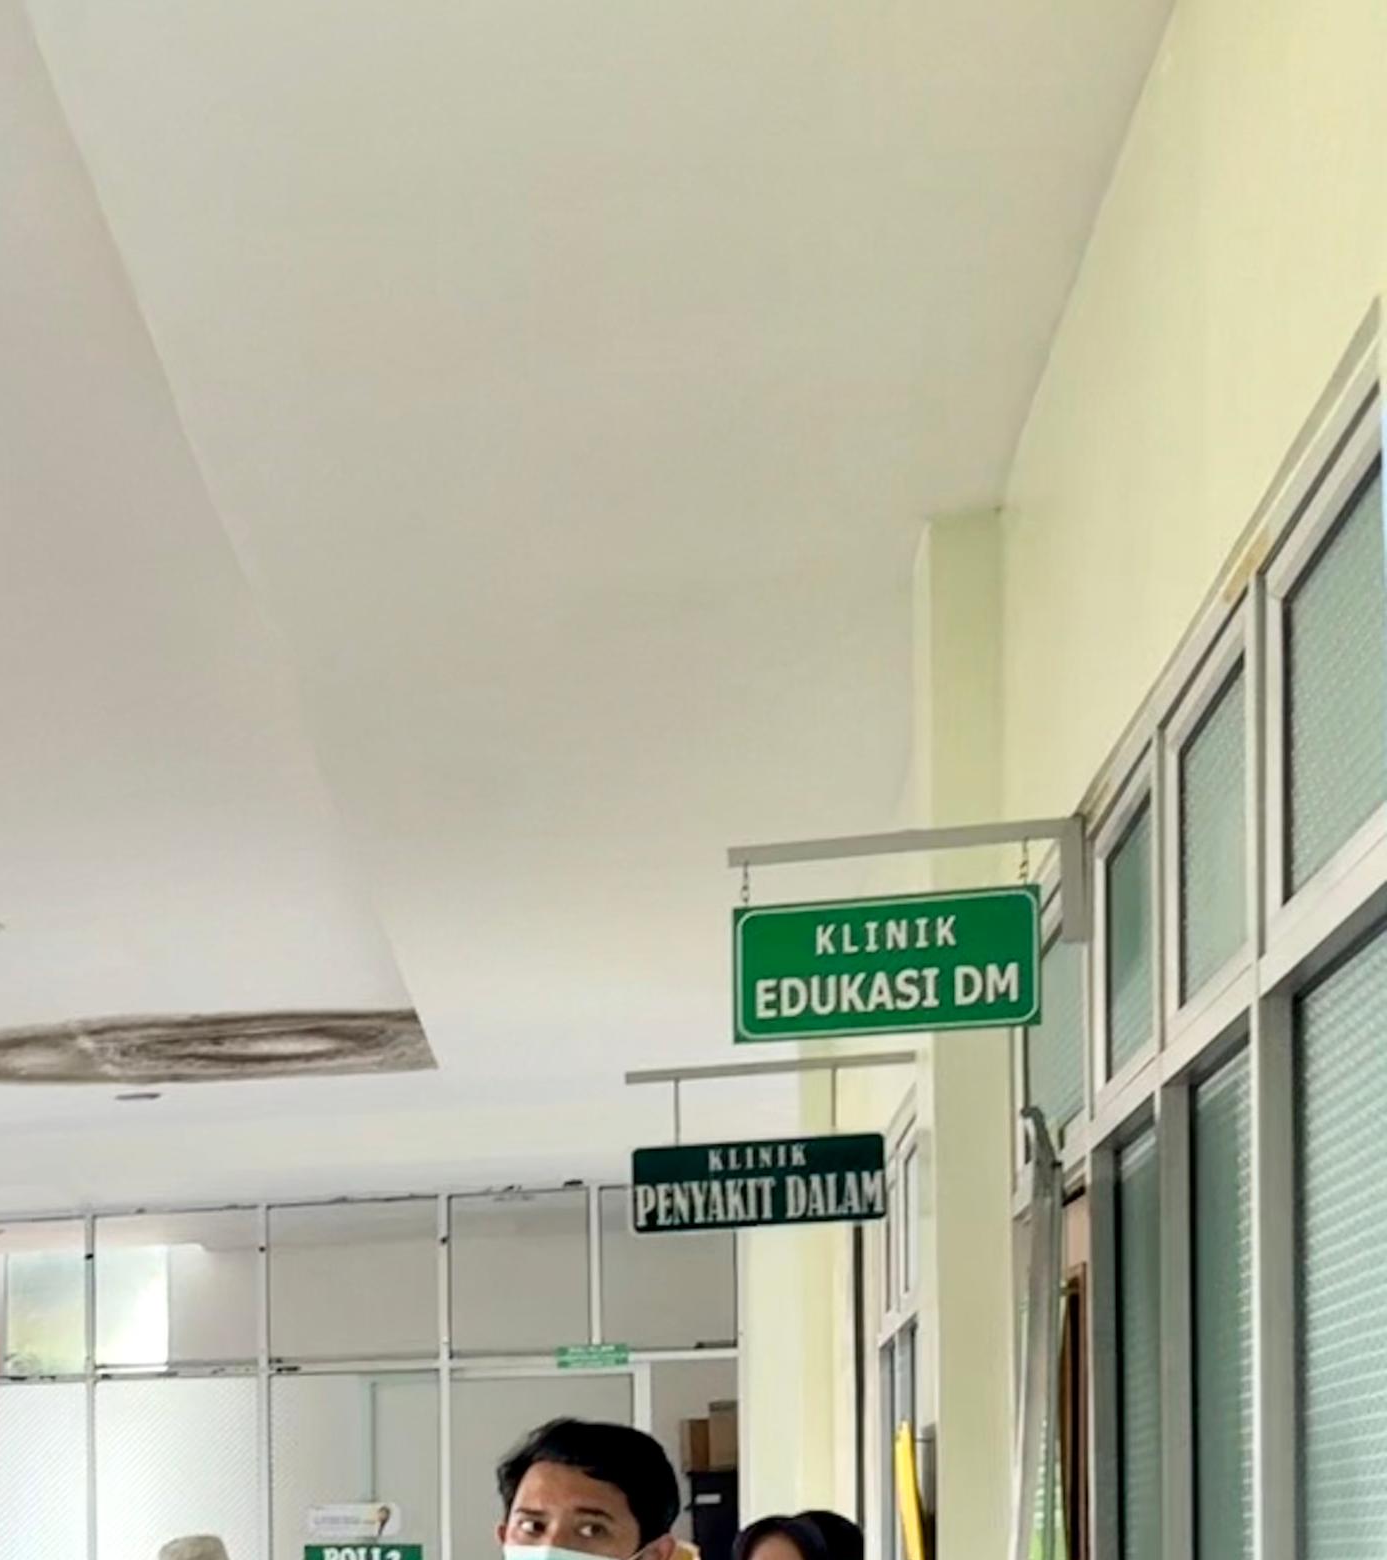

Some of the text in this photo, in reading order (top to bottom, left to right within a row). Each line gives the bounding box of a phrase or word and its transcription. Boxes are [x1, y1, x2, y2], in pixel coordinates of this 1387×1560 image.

[815, 915, 958, 956] KLINIK
[755, 963, 1019, 1019] EDUKASI DM
[708, 1143, 807, 1172] KLINIK
[635, 1169, 886, 1227] PENYAKIT DALAM
